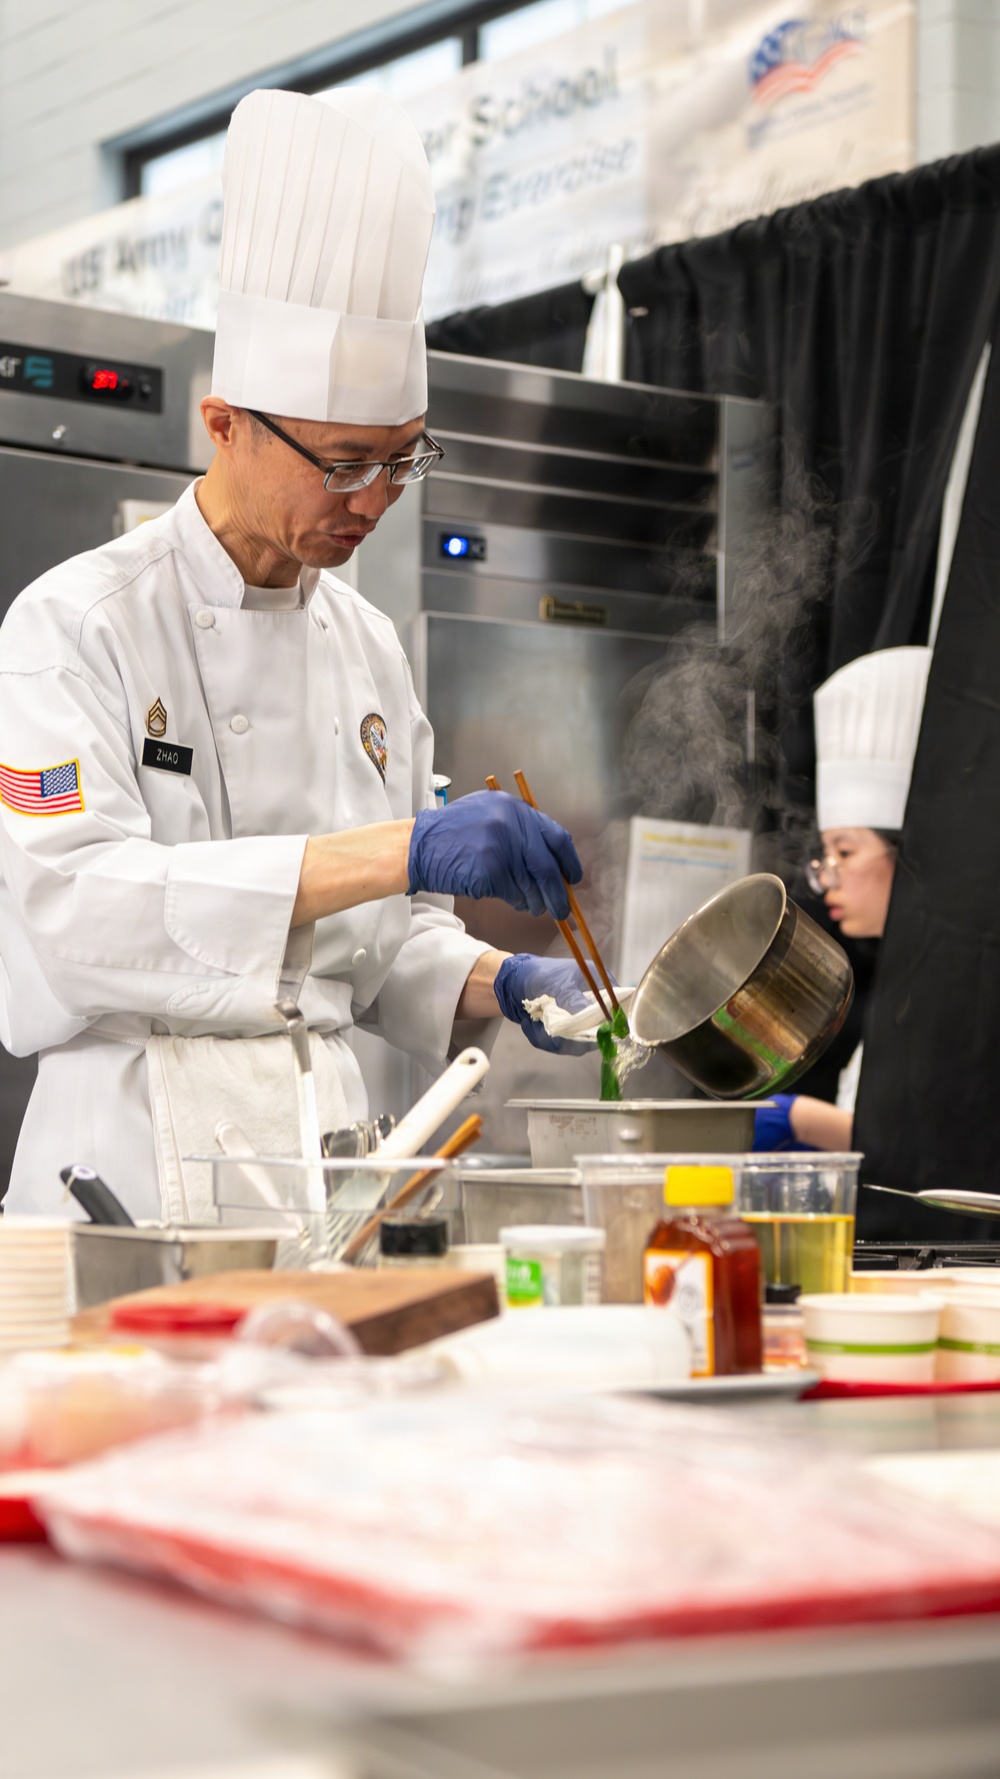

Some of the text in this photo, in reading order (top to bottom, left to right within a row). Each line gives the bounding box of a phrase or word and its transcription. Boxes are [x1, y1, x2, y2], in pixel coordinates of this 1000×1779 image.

[471, 46, 619, 147] School
[113, 226, 192, 275] Army
[156, 748, 178, 764] ZHAO
